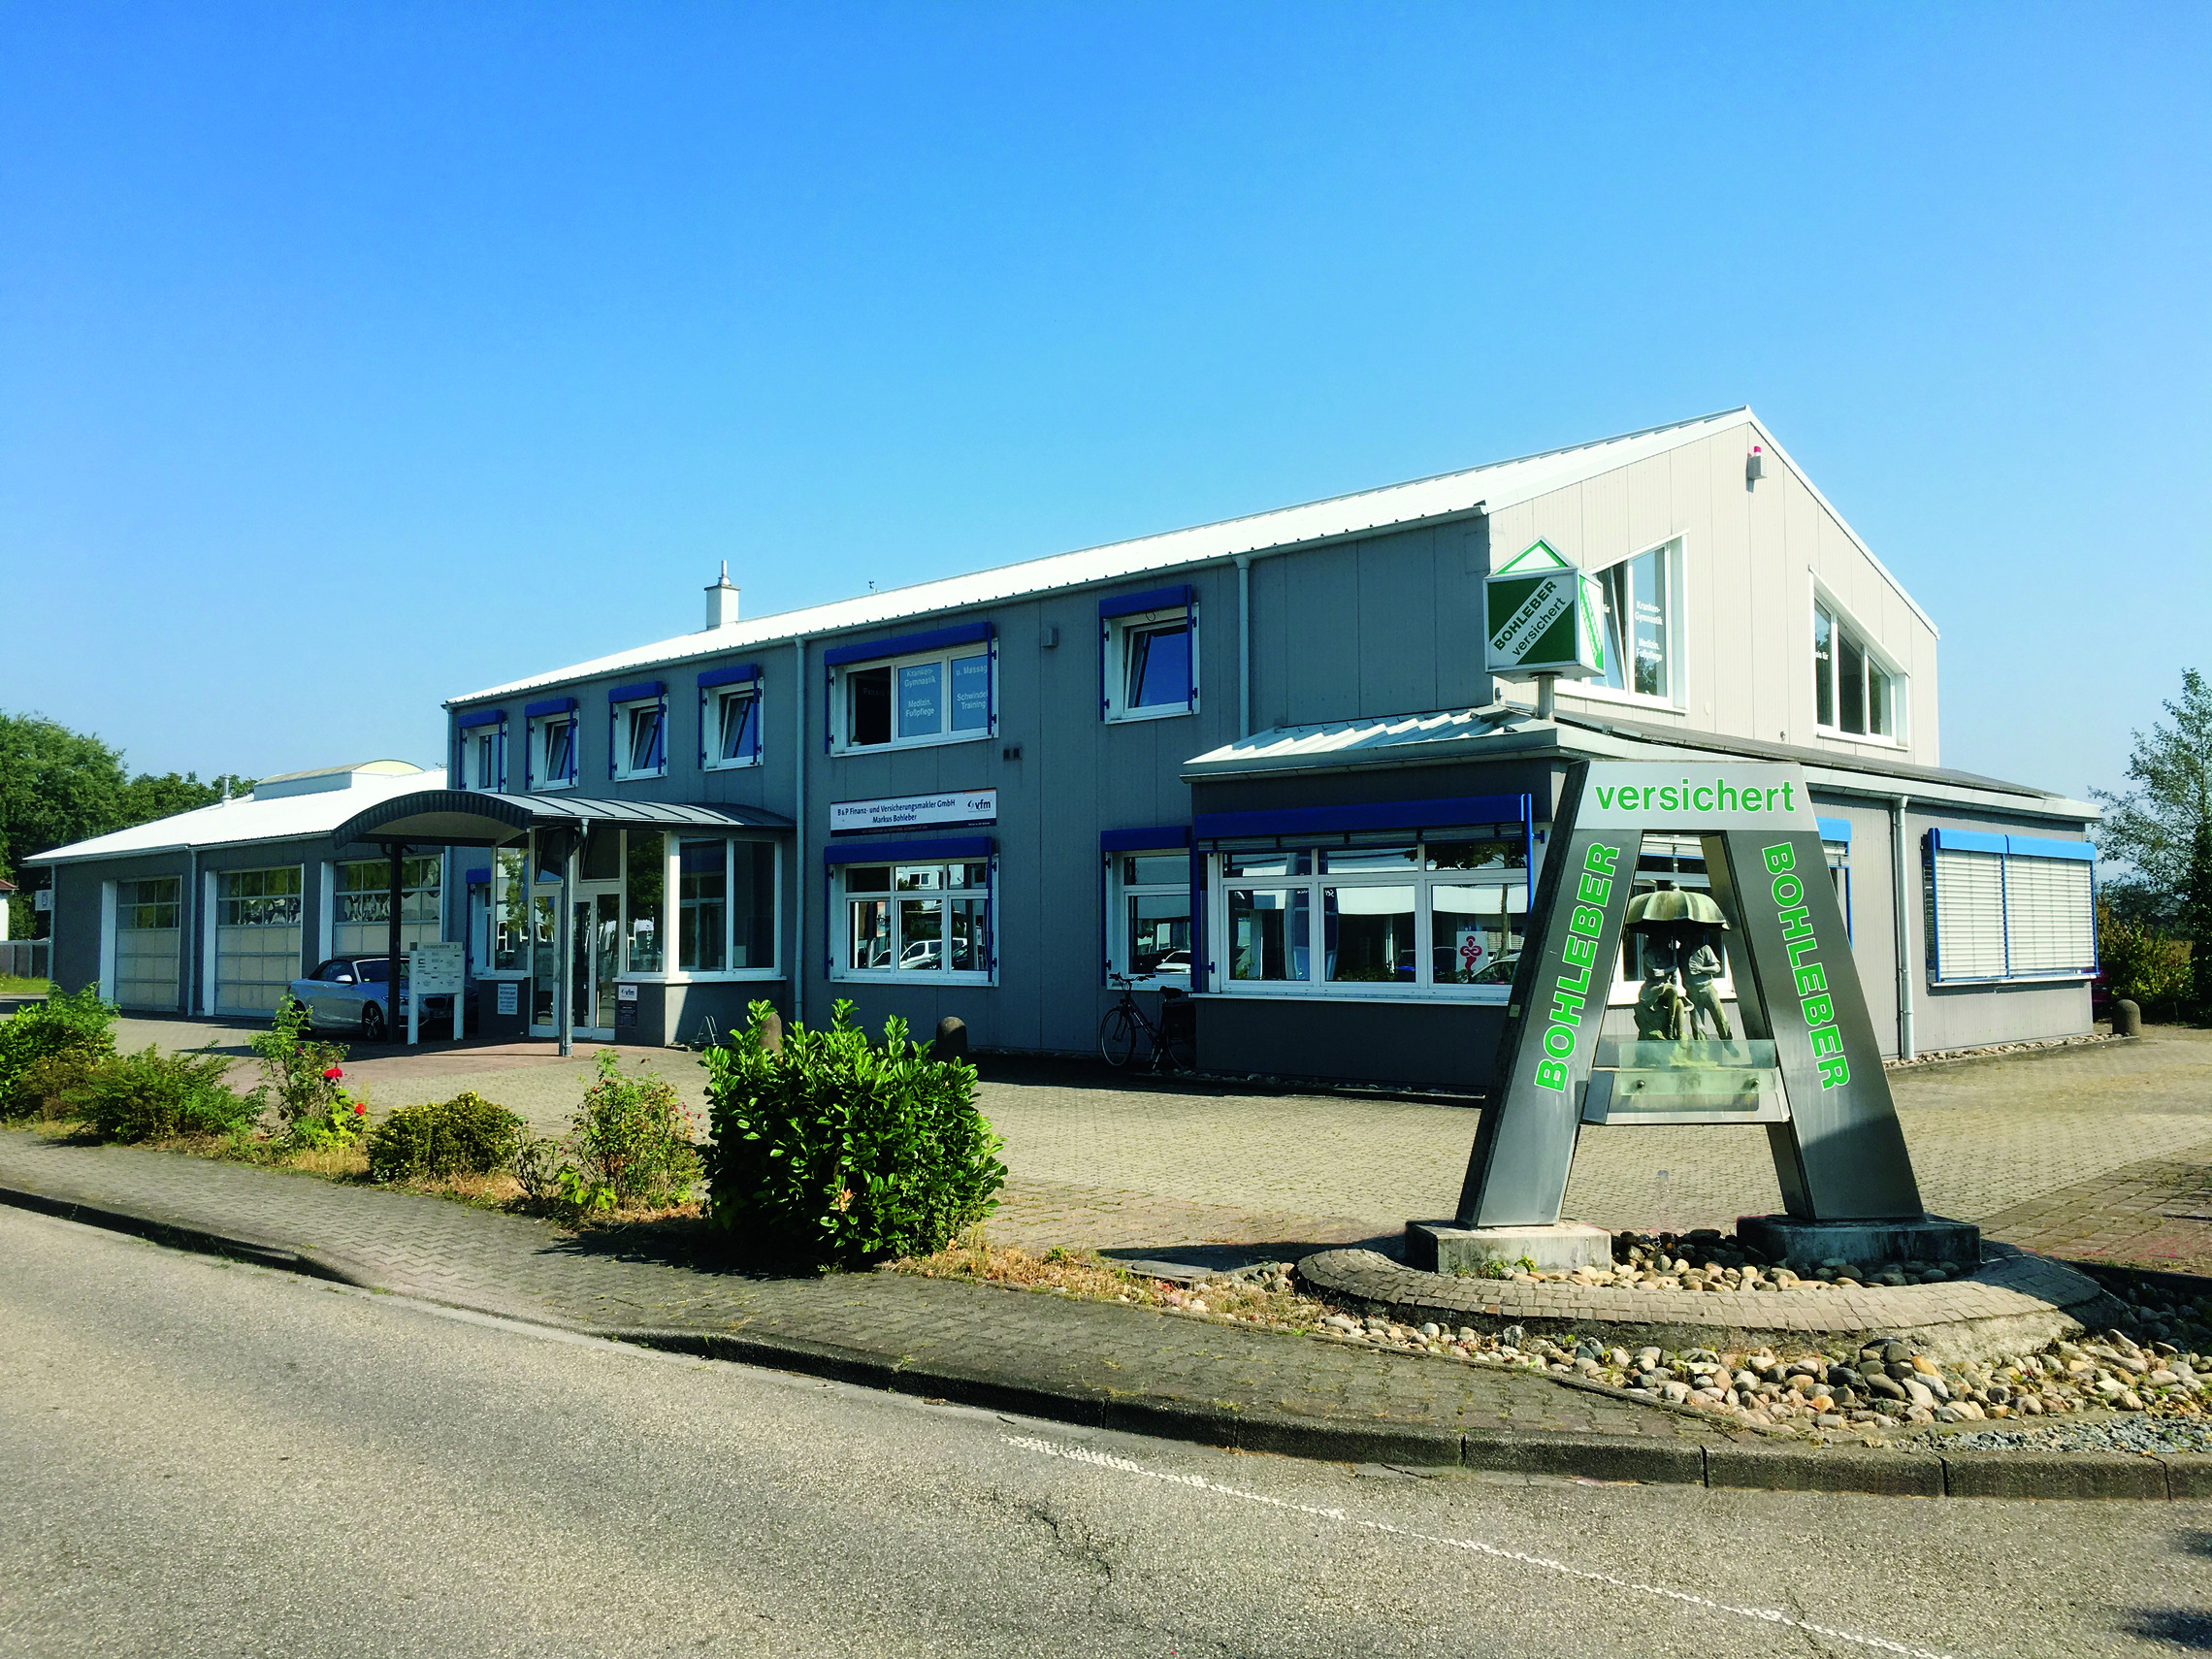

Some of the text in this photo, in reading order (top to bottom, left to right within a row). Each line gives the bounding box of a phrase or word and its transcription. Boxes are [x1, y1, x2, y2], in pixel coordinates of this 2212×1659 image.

[1493, 580, 1557, 651] BOHLEBER
[1634, 611, 1663, 626] Gymnastik
[1512, 597, 1566, 657] versichert
[906, 667, 934, 678] Kranken-
[963, 665, 988, 674] Massag
[904, 676, 936, 688] Gymnastik
[908, 699, 932, 708] Medizin.
[961, 699, 987, 710] Training
[905, 707, 935, 718] Fußpflege
[1594, 777, 1796, 813] versichert
[869, 805, 880, 814] und
[880, 800, 936, 812] Versicherungsmakler
[936, 798, 956, 808] GmbH
[974, 798, 992, 810] vfm
[872, 814, 917, 824] Markus Bohleber
[1533, 841, 1621, 1093] BOHLEBER
[1761, 840, 1851, 1091] BOHLEBER
